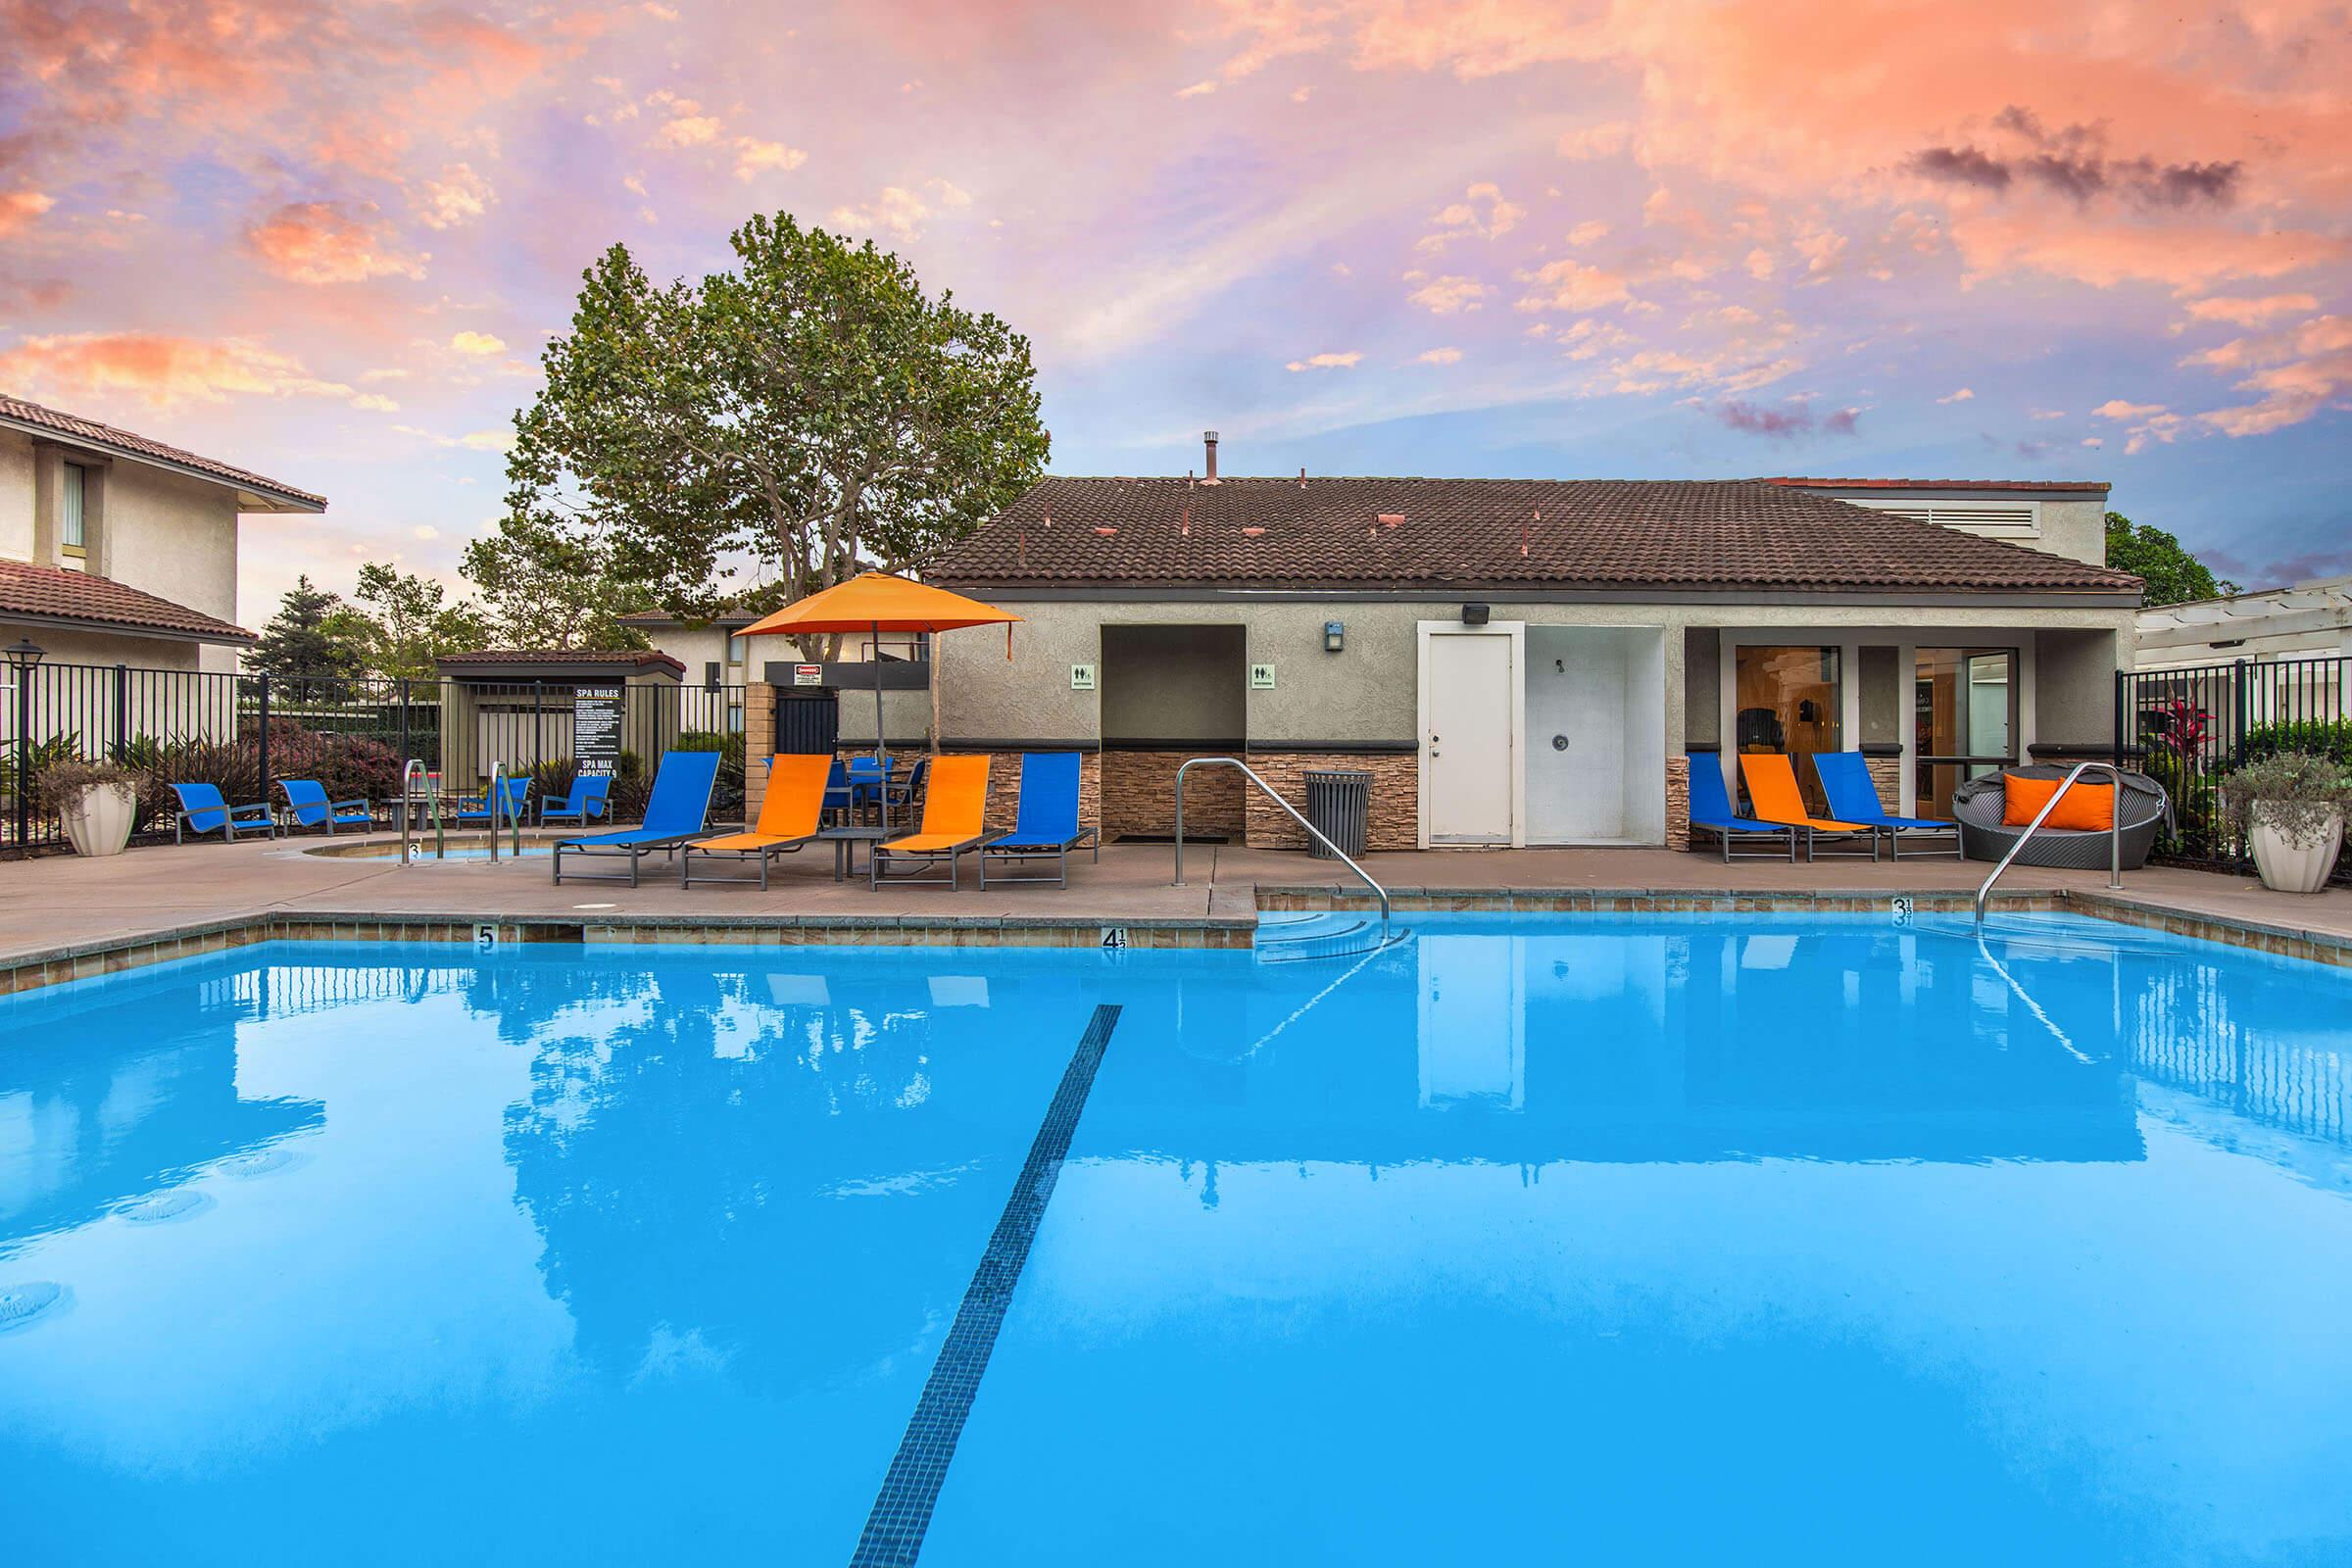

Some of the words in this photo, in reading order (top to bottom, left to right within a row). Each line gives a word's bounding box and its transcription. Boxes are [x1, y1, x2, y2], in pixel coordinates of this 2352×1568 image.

[576, 689, 593, 698] SPA
[594, 689, 619, 698] RULES
[582, 760, 596, 769] SPA
[597, 760, 612, 769] MAX
[612, 769, 617, 778] 9
[410, 844, 418, 856] 3
[479, 925, 493, 943] 5
